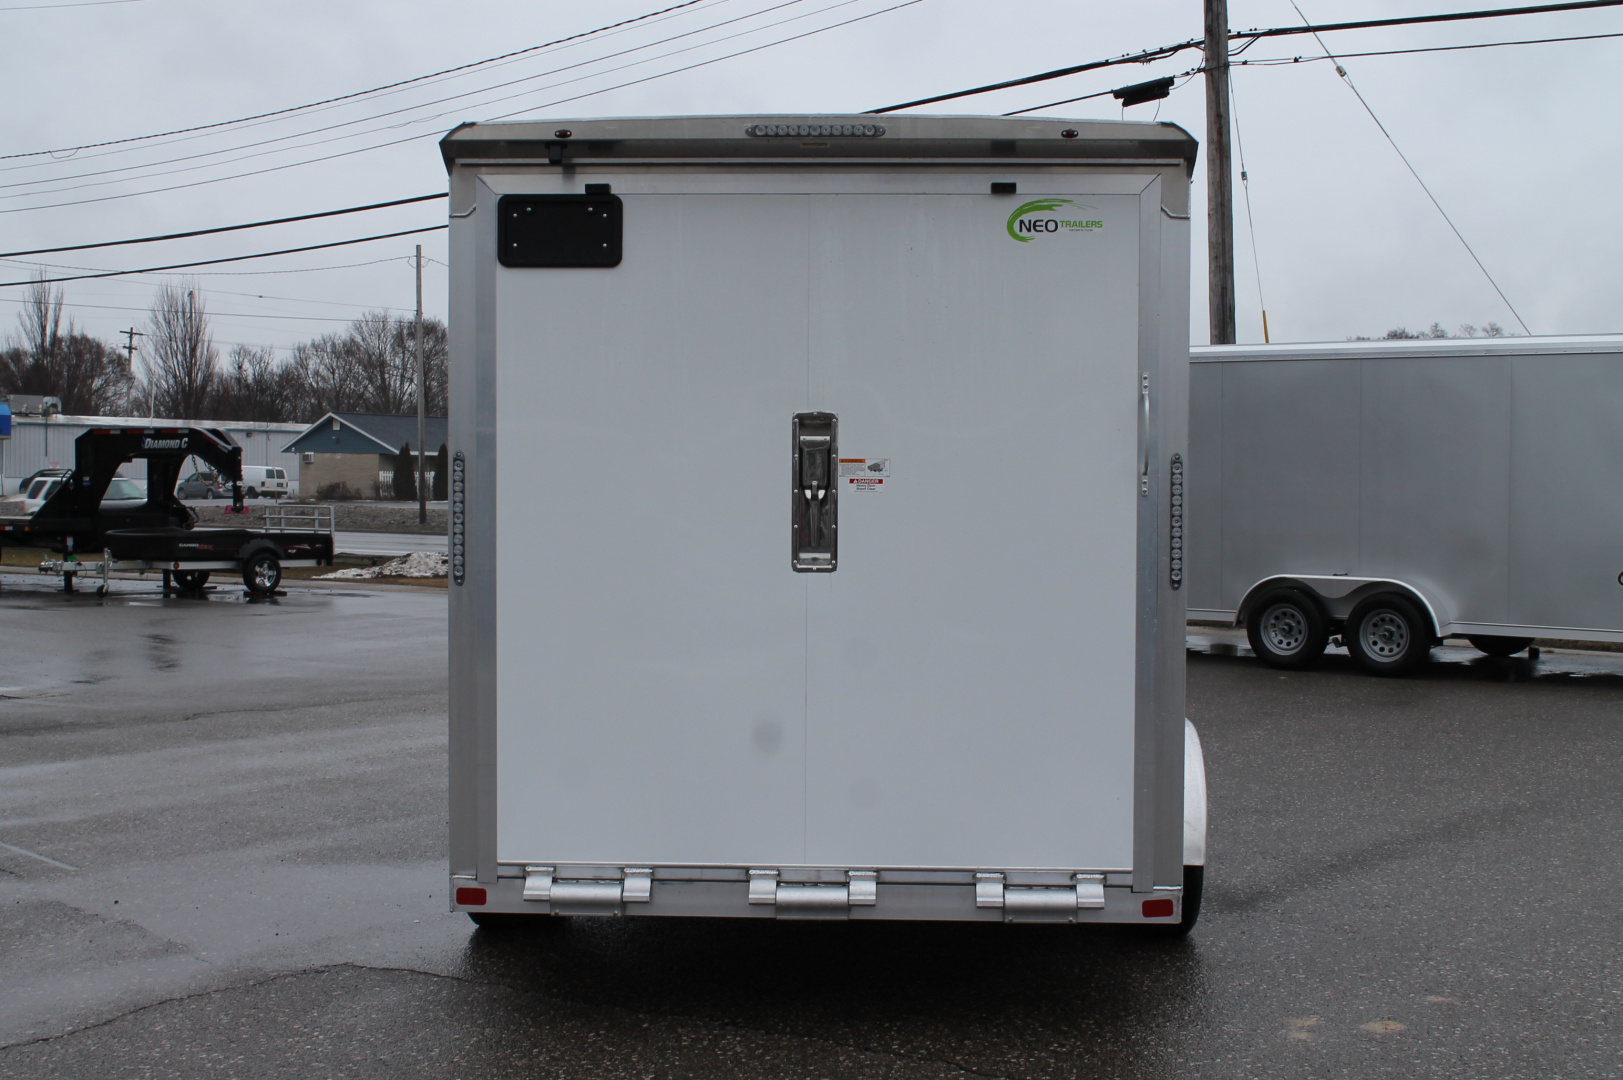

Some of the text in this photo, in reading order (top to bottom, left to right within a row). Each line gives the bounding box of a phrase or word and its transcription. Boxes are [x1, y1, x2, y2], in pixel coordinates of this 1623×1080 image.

[1019, 219, 1103, 233] NEO TRAILERS
[144, 437, 188, 448] DIAMOND C
